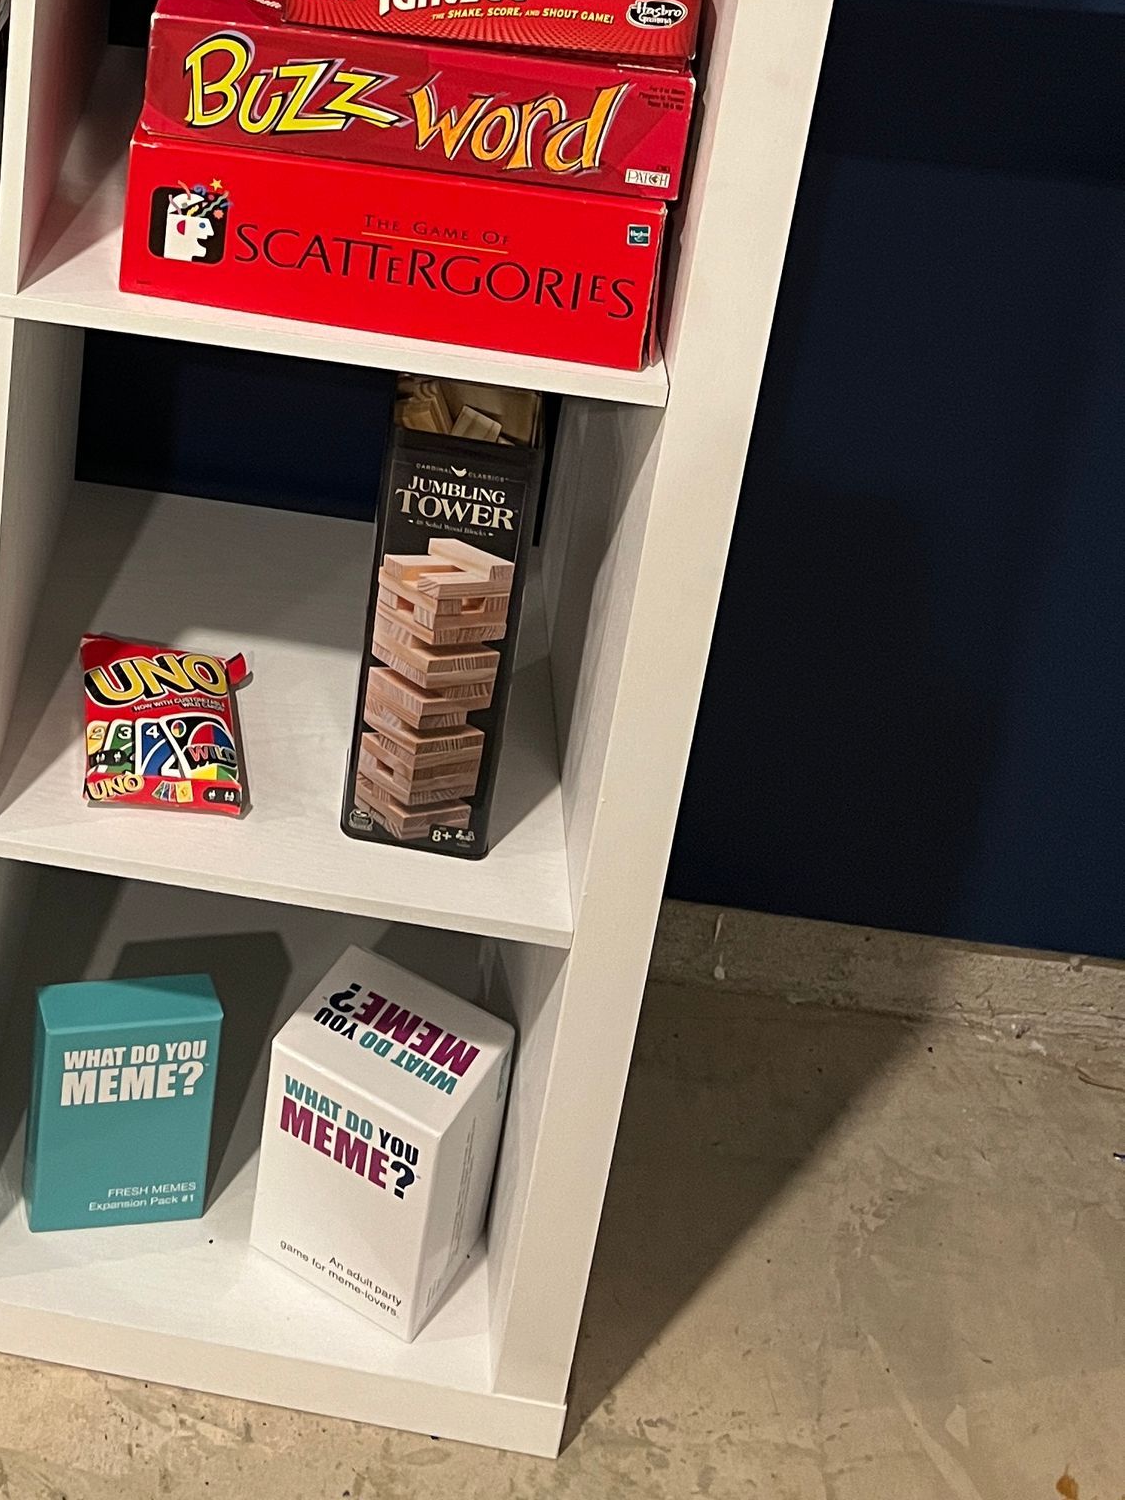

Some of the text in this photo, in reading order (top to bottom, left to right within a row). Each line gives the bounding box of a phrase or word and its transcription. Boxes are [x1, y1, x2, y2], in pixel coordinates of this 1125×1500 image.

[431, 6, 615, 25] THE SHAKE, SCORE, AND SHOUT GAME!
[635, 1, 684, 20] Hasbro
[234, 222, 638, 321] SCATTERGORIES
[415, 463, 453, 474] CARDINAL
[407, 475, 507, 505] JUMBLING
[394, 488, 515, 531] TOWER
[86, 653, 229, 705] UNO
[133, 703, 153, 712] NOW
[153, 699, 174, 708] WITH
[117, 725, 161, 740] 3 4
[86, 773, 145, 800] UNO
[431, 829, 452, 842] 8+
[313, 1006, 360, 1041] YOU
[327, 981, 481, 1079] MEME?
[63, 1039, 208, 1071] WHAT DO YOU
[358, 1030, 393, 1059] DO
[60, 1061, 205, 1107] MEME?
[390, 1047, 459, 1096] WHAT
[284, 1073, 421, 1168] WHAT DO YOU
[279, 1095, 417, 1200] MEME?
[88, 1195, 179, 1211] Expansion Pack
[107, 1181, 197, 1199] FRESH MEMES
[279, 1240, 310, 1262] game
[311, 1257, 327, 1272] for
[328, 1256, 345, 1272] An
[346, 1268, 373, 1289] adult
[374, 1285, 402, 1307] party
